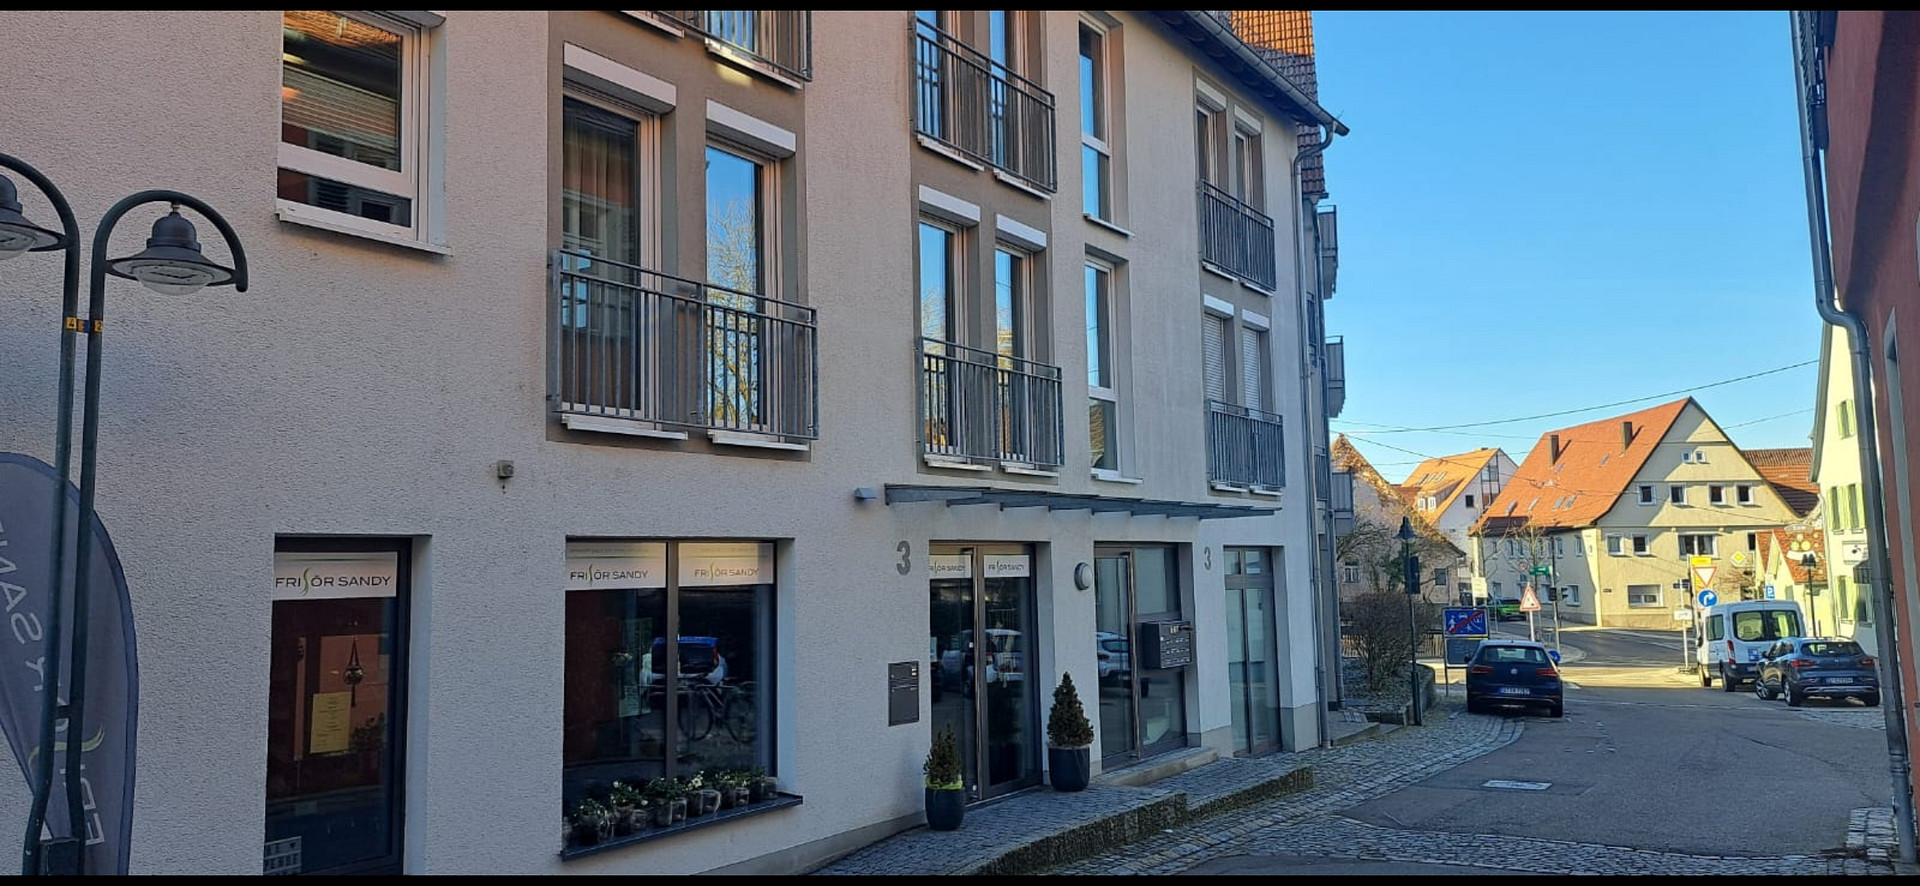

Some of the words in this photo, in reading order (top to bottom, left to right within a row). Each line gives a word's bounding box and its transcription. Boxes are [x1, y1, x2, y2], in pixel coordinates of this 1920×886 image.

[896, 541, 911, 575] 3
[1204, 546, 1211, 570] 3
[275, 567, 335, 596] FRISÖR
[338, 575, 391, 587] SANDY
[612, 570, 648, 580] SANDY
[729, 567, 759, 577] SANDY
